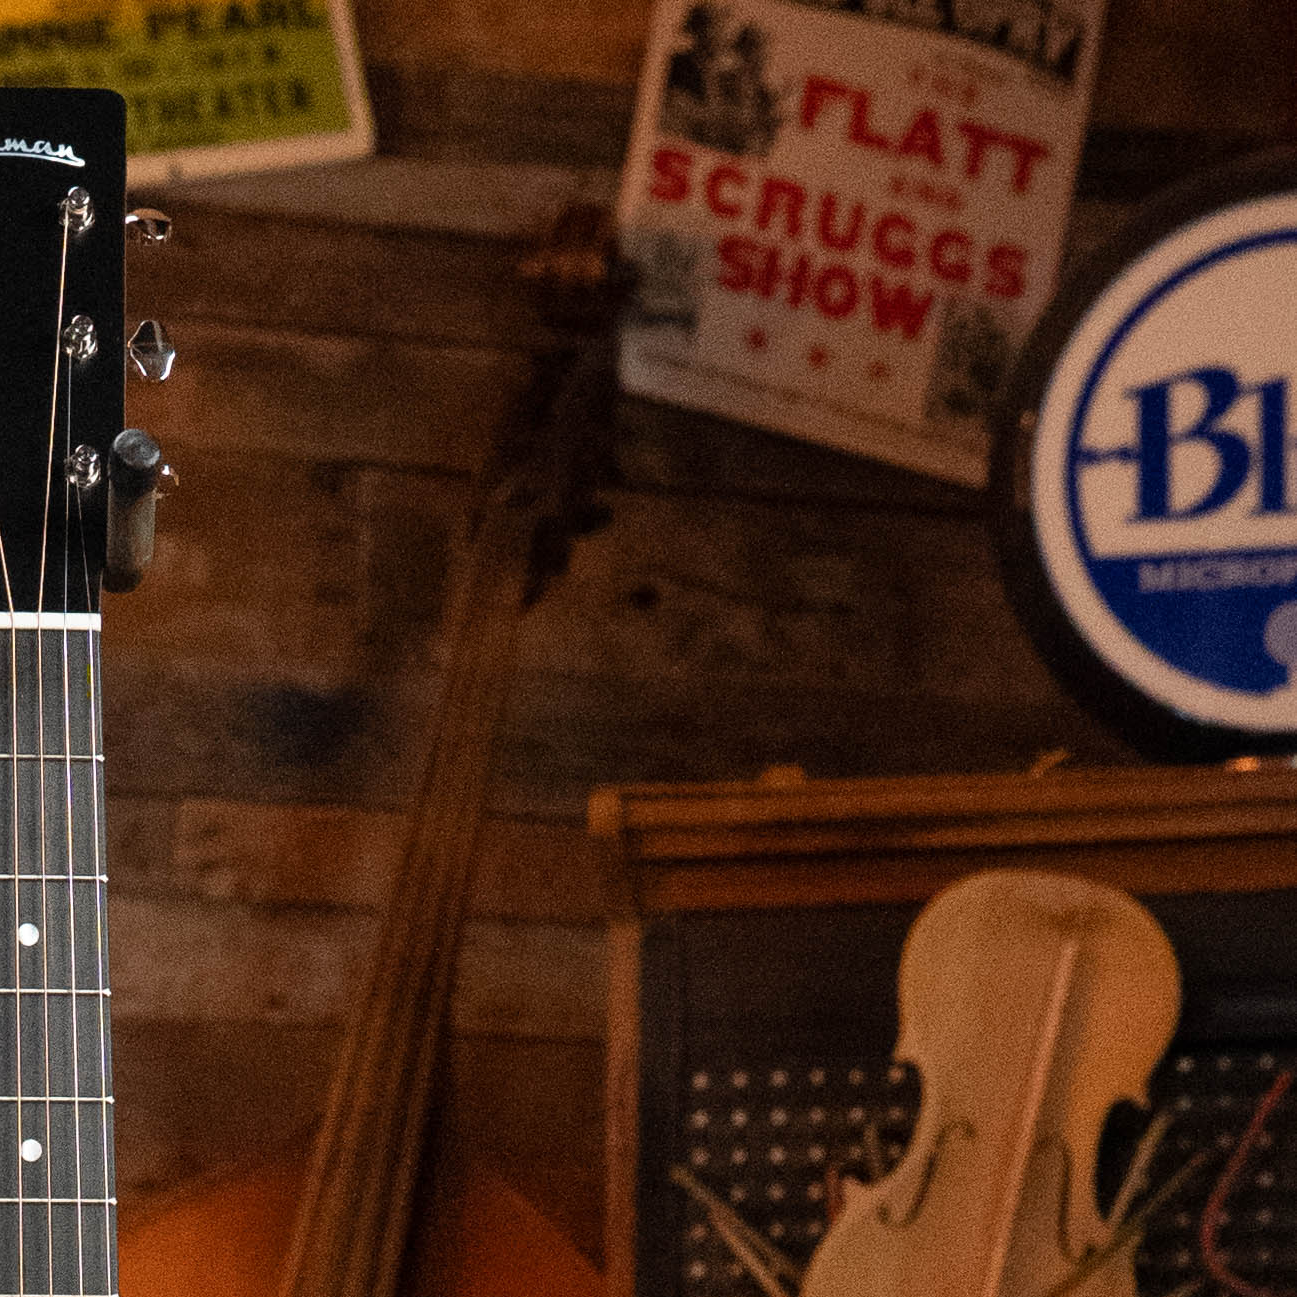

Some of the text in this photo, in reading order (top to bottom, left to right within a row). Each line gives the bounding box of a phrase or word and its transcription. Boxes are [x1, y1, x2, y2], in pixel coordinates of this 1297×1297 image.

[802, 74, 1050, 194] FLATT
[649, 147, 1029, 299] SCRUGGS
[716, 236, 934, 341] SHOW
[1124, 367, 1297, 524] Bl
